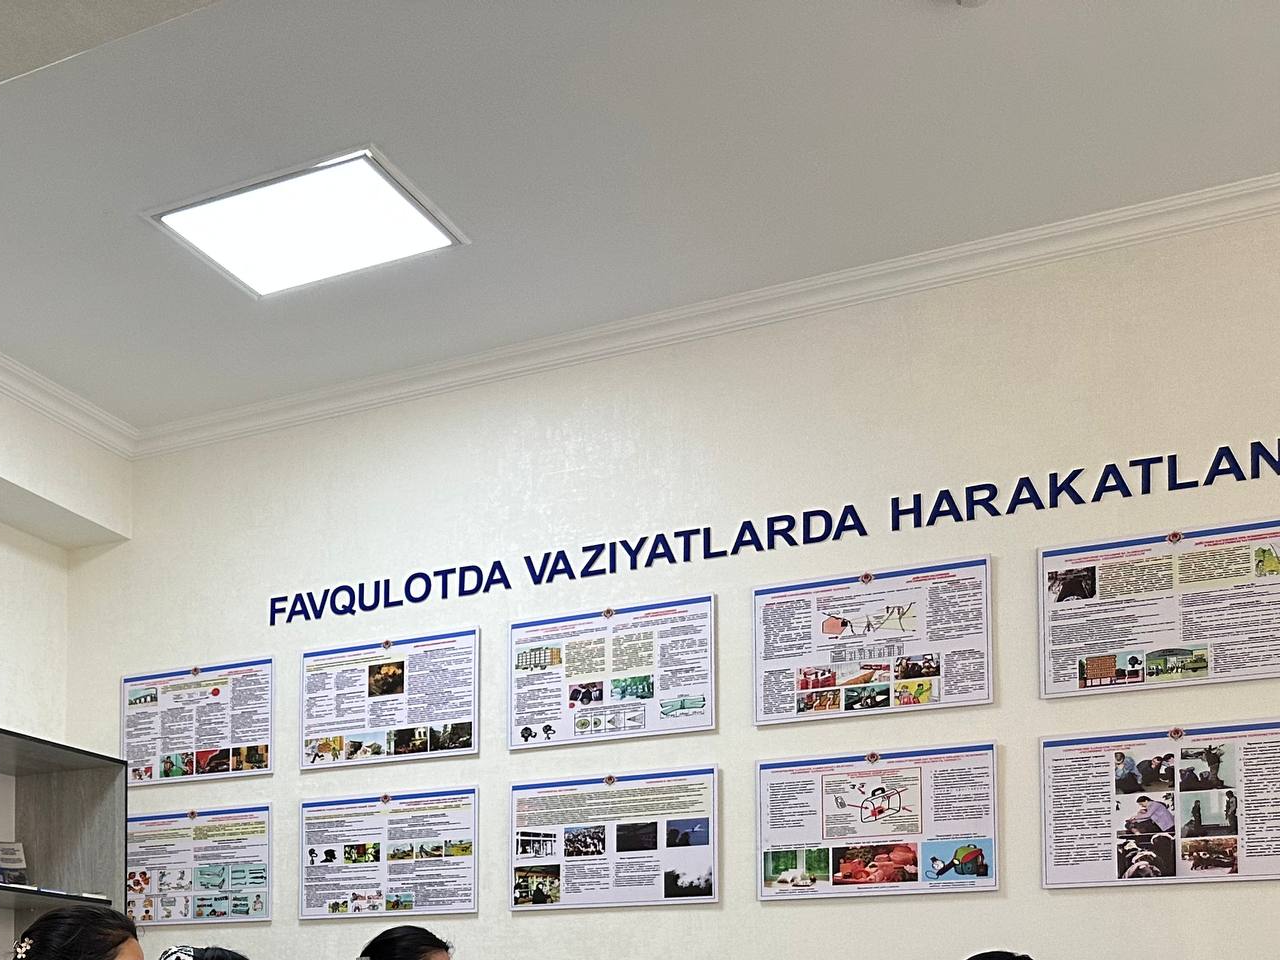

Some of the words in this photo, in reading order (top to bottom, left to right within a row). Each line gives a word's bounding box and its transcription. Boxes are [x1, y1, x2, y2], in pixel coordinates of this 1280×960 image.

[269, 561, 511, 625] FAVQULOTDA
[524, 504, 866, 586] VAZIYATLARDA
[890, 438, 1280, 531] HARAKATLAN
